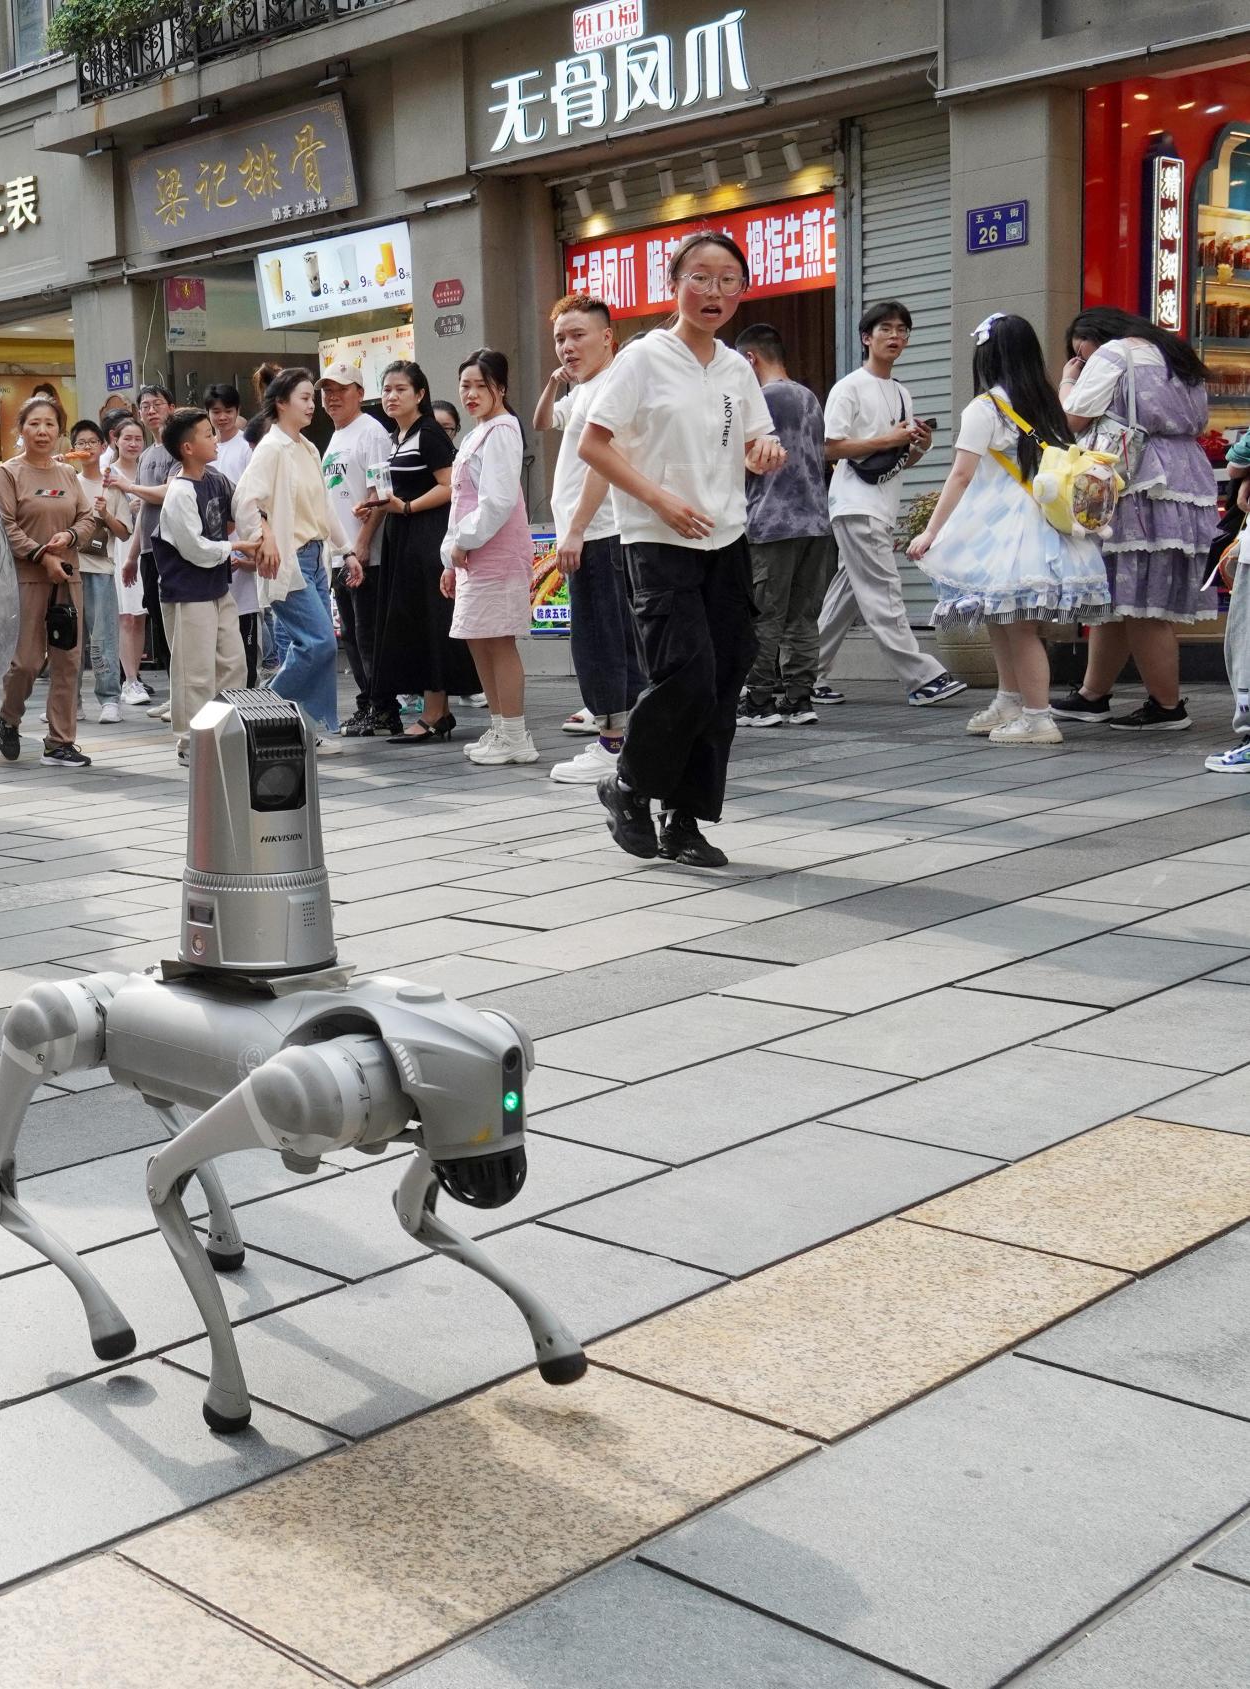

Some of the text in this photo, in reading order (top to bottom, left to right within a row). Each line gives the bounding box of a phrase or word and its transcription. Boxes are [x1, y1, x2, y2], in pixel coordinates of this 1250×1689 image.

[575, 26, 638, 52] WEIKOUFU
[488, 9, 751, 152] 无骨凤爪
[155, 123, 327, 227] 梁记排骨
[271, 196, 328, 221] 奶茶 冰淇淋
[975, 207, 1019, 224] 五马街
[979, 225, 998, 245] 26
[111, 374, 120, 386] 30
[722, 393, 733, 447] ANOTHER
[536, 608, 570, 619] 脆皮五花
[260, 833, 303, 843] HIKVISION
